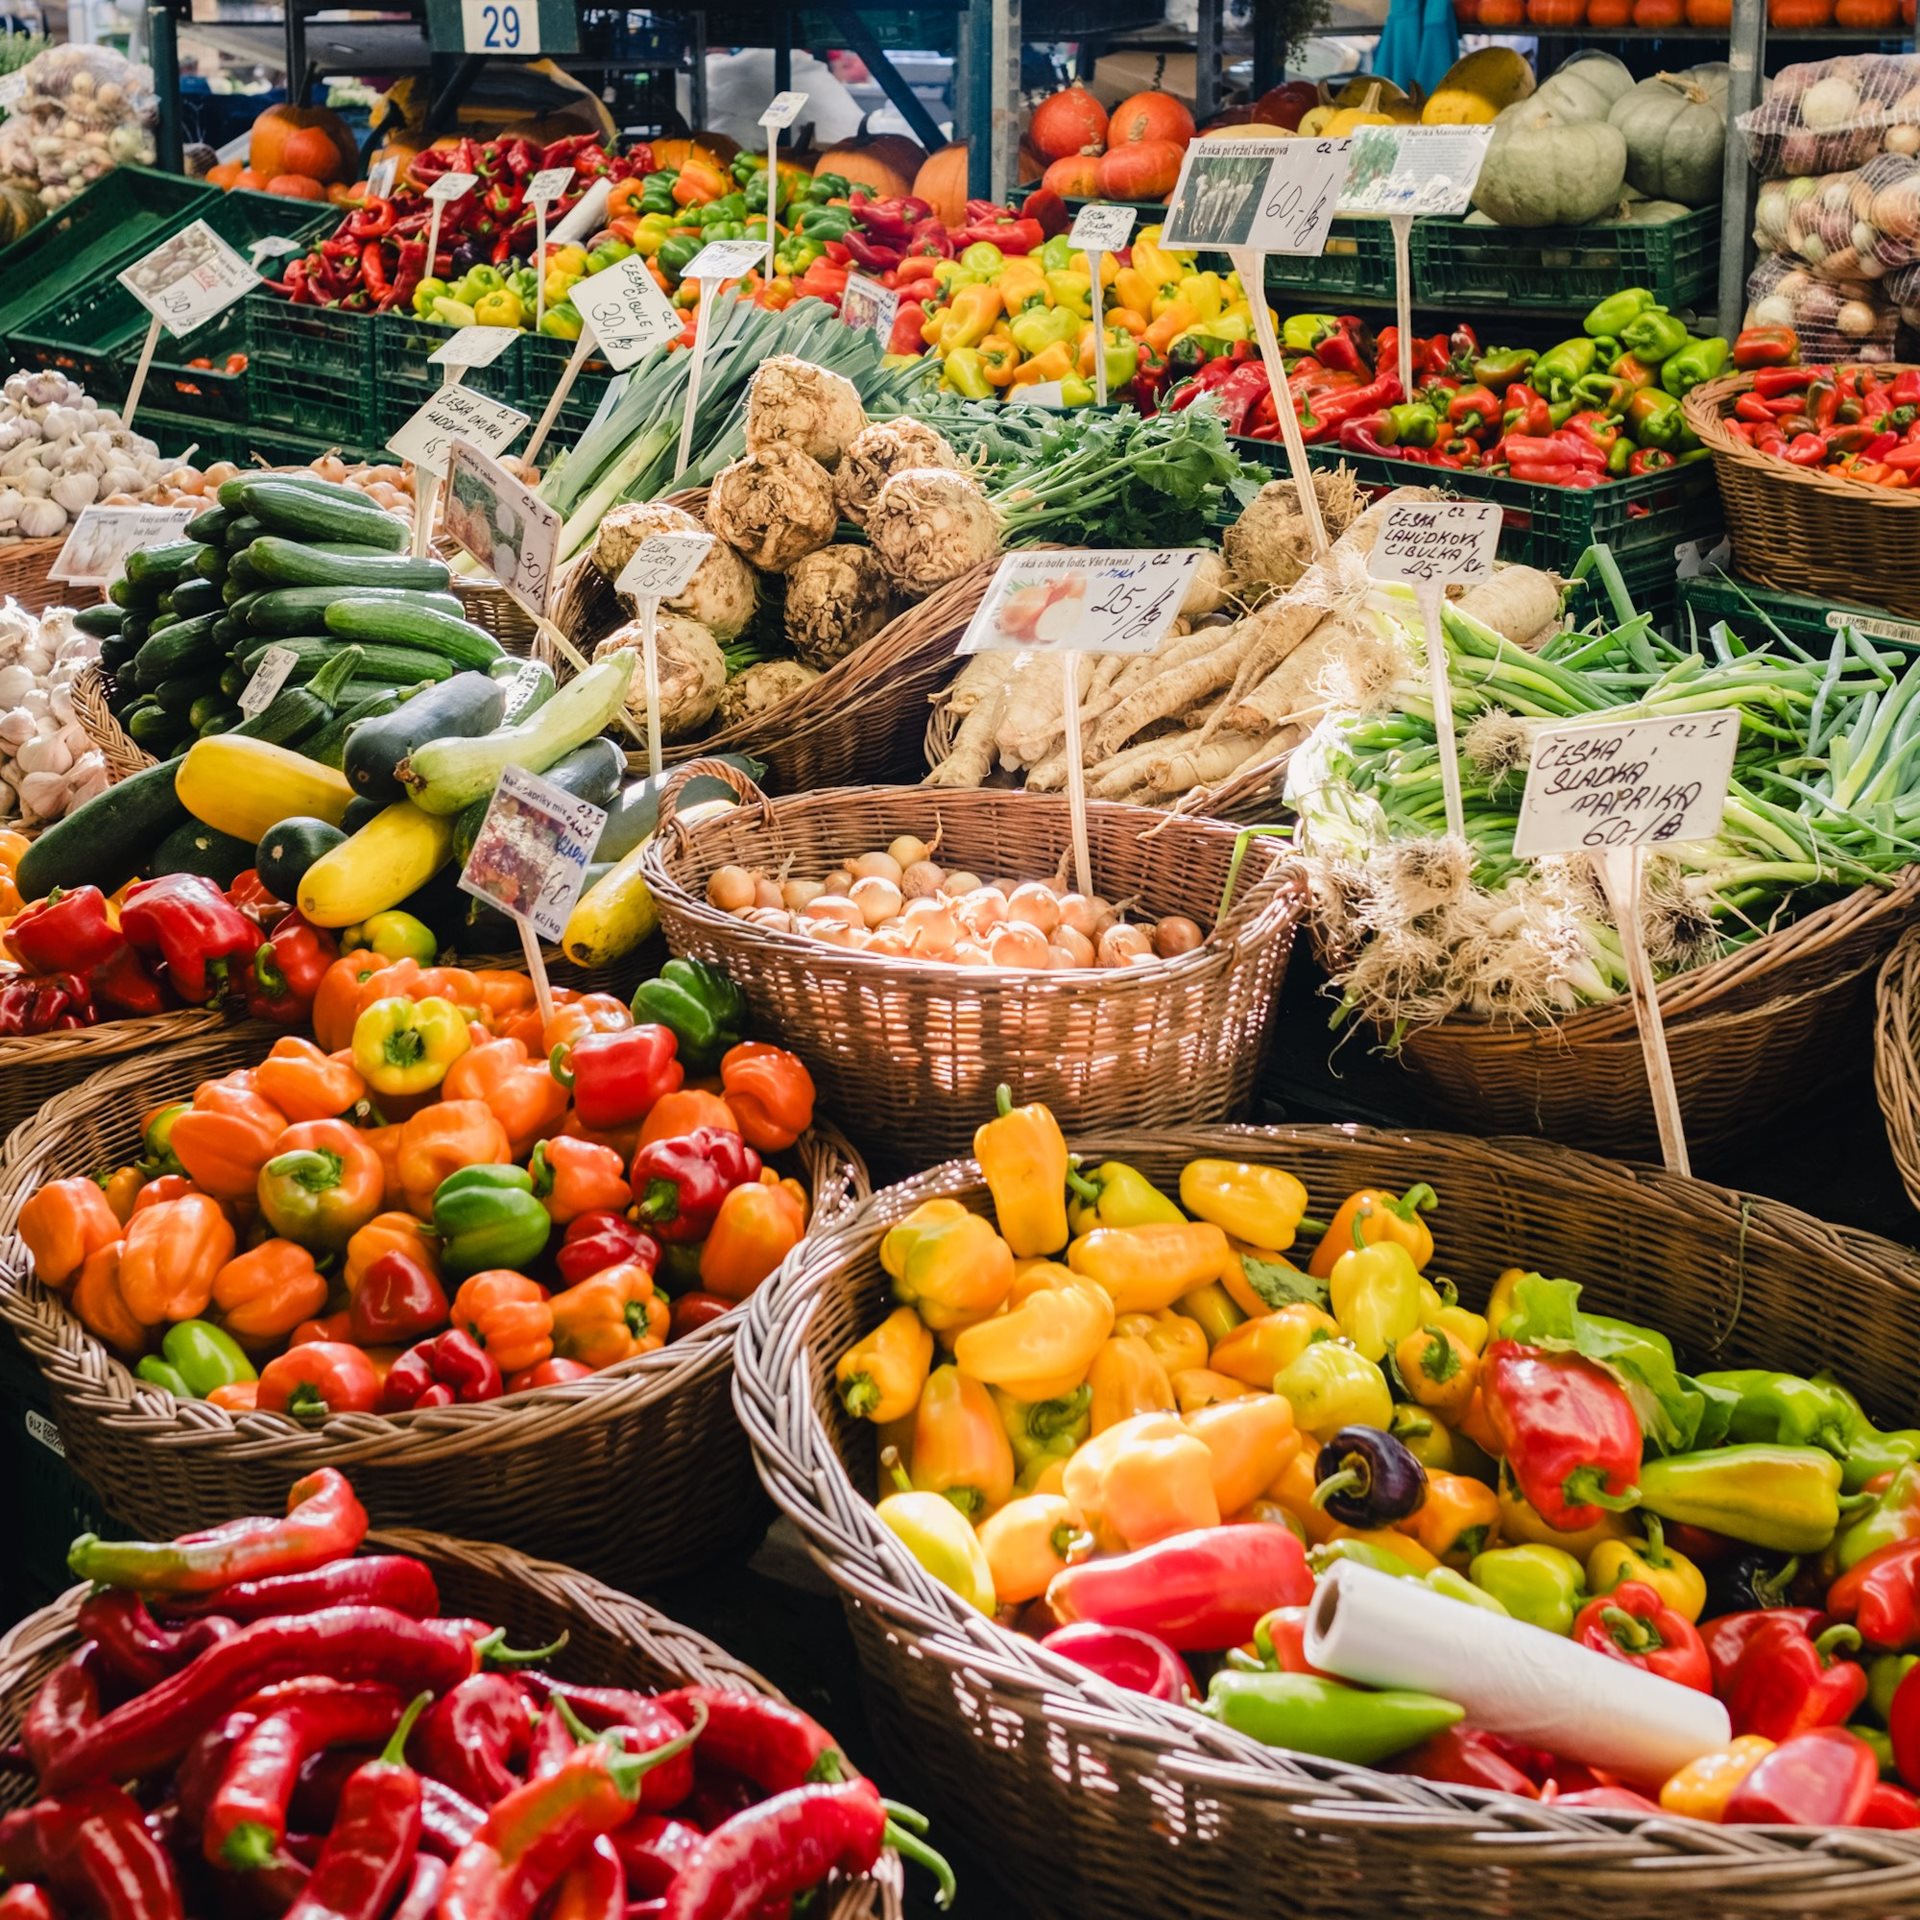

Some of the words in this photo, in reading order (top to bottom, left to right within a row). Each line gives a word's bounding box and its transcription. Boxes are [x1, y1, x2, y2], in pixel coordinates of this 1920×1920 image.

[482, 5, 520, 48] 29
[622, 288, 654, 328] CIBULE
[436, 389, 481, 416] ČESKÁ
[467, 414, 505, 440] OKURKA
[521, 496, 537, 516] CZ
[1388, 508, 1443, 528] ČESKÁ
[1448, 507, 1464, 518] CZ
[1477, 508, 1489, 520] I
[1152, 553, 1171, 566] CZ
[1384, 544, 1462, 560] CIBULKA
[1669, 724, 1694, 738] CZ
[1703, 719, 1728, 739] I
[1536, 729, 1635, 770] ČESKÁ
[1544, 747, 1658, 795] SLADKÁ
[1568, 781, 1702, 818] PAPRIKA
[542, 871, 571, 906] 60
[534, 911, 561, 934] Kč/kg
